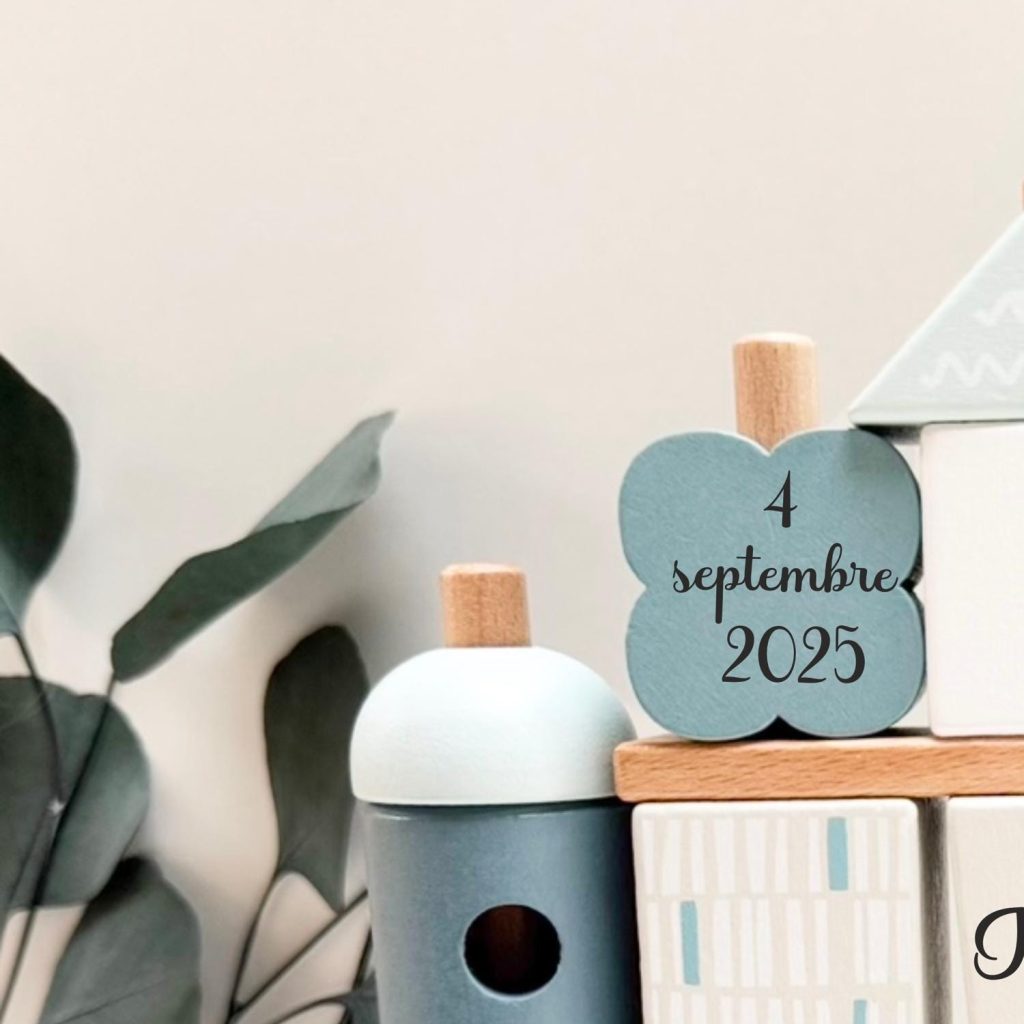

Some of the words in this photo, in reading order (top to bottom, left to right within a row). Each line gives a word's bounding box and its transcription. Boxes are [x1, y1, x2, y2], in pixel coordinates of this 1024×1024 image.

[763, 470, 798, 528] 4
[672, 542, 899, 624] septembre
[721, 625, 867, 684] 2025
